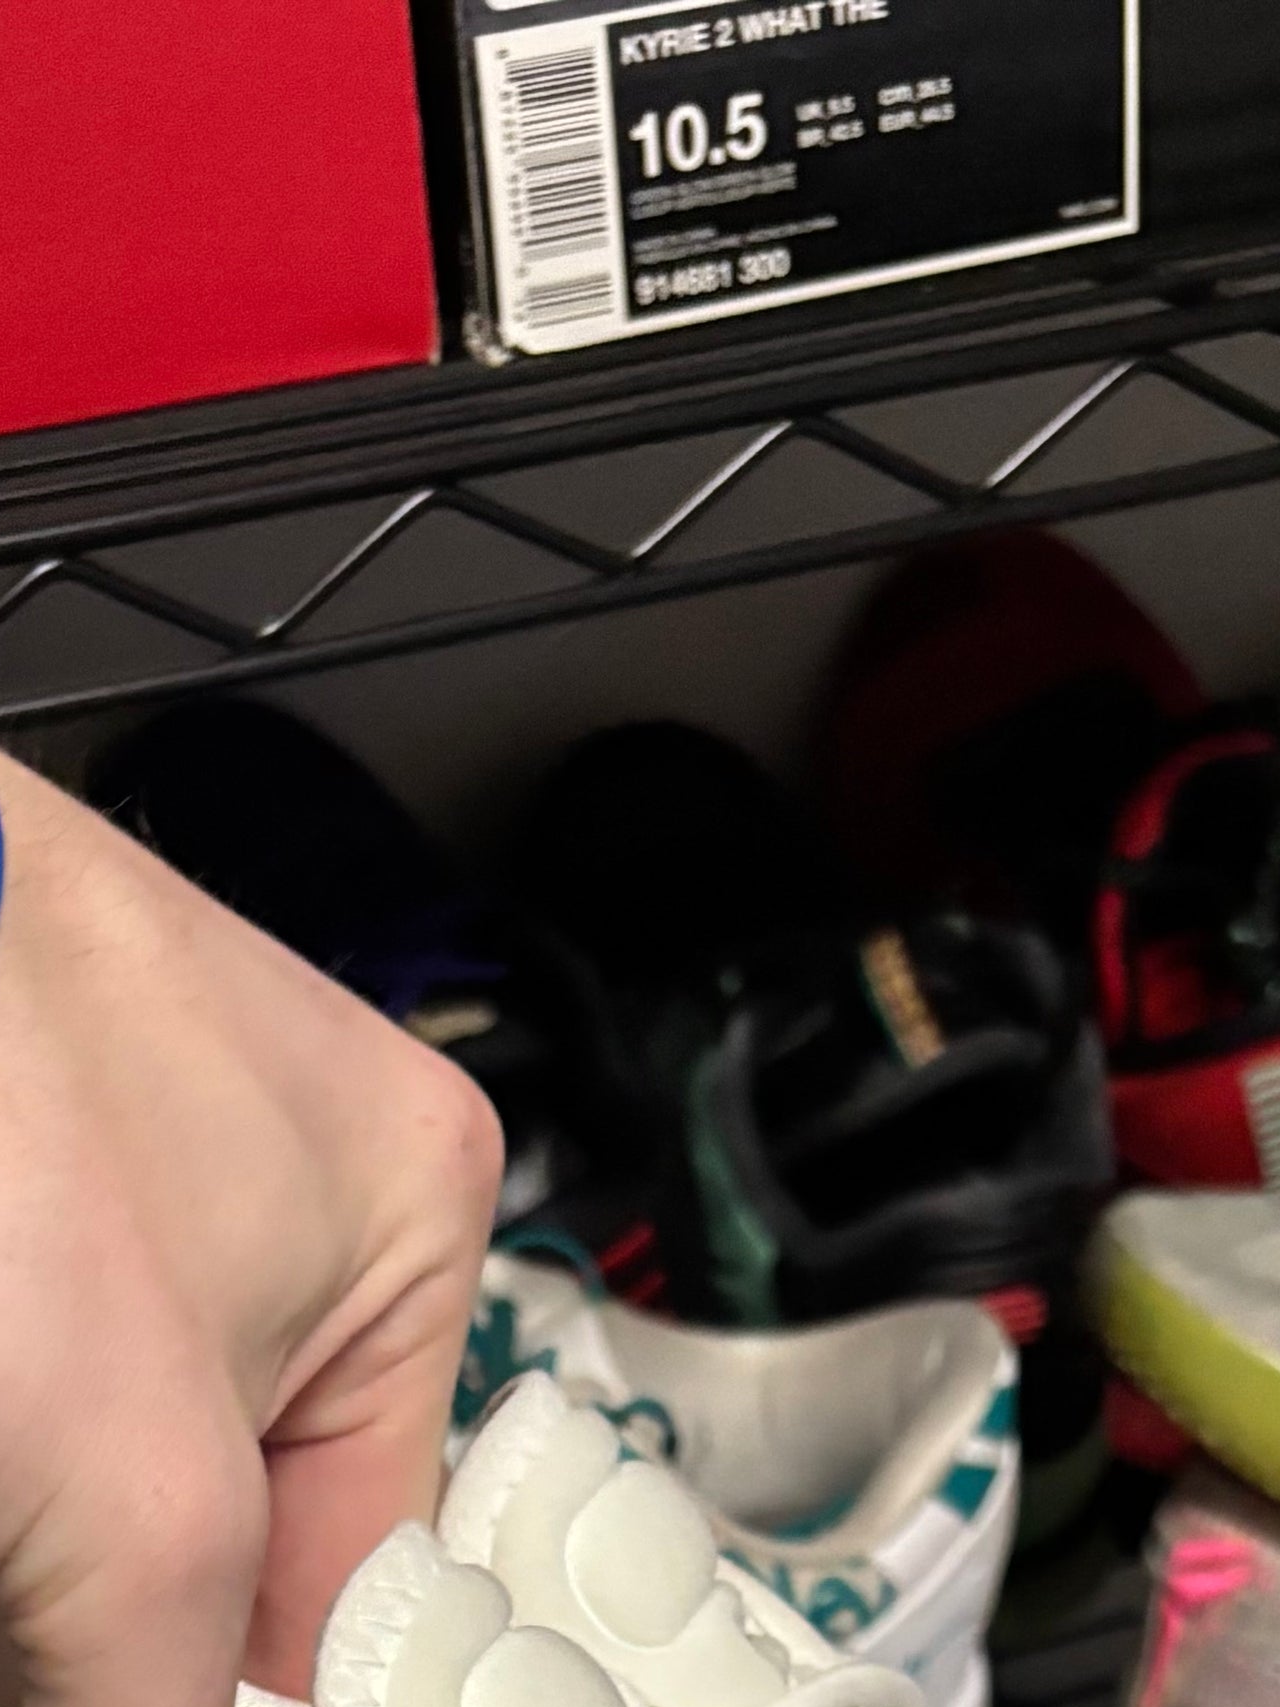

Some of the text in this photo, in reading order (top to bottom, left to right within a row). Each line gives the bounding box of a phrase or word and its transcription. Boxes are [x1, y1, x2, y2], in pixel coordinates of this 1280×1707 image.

[620, 0, 890, 67] KYRIE 2 WHAT THE
[629, 90, 768, 179] 10.5
